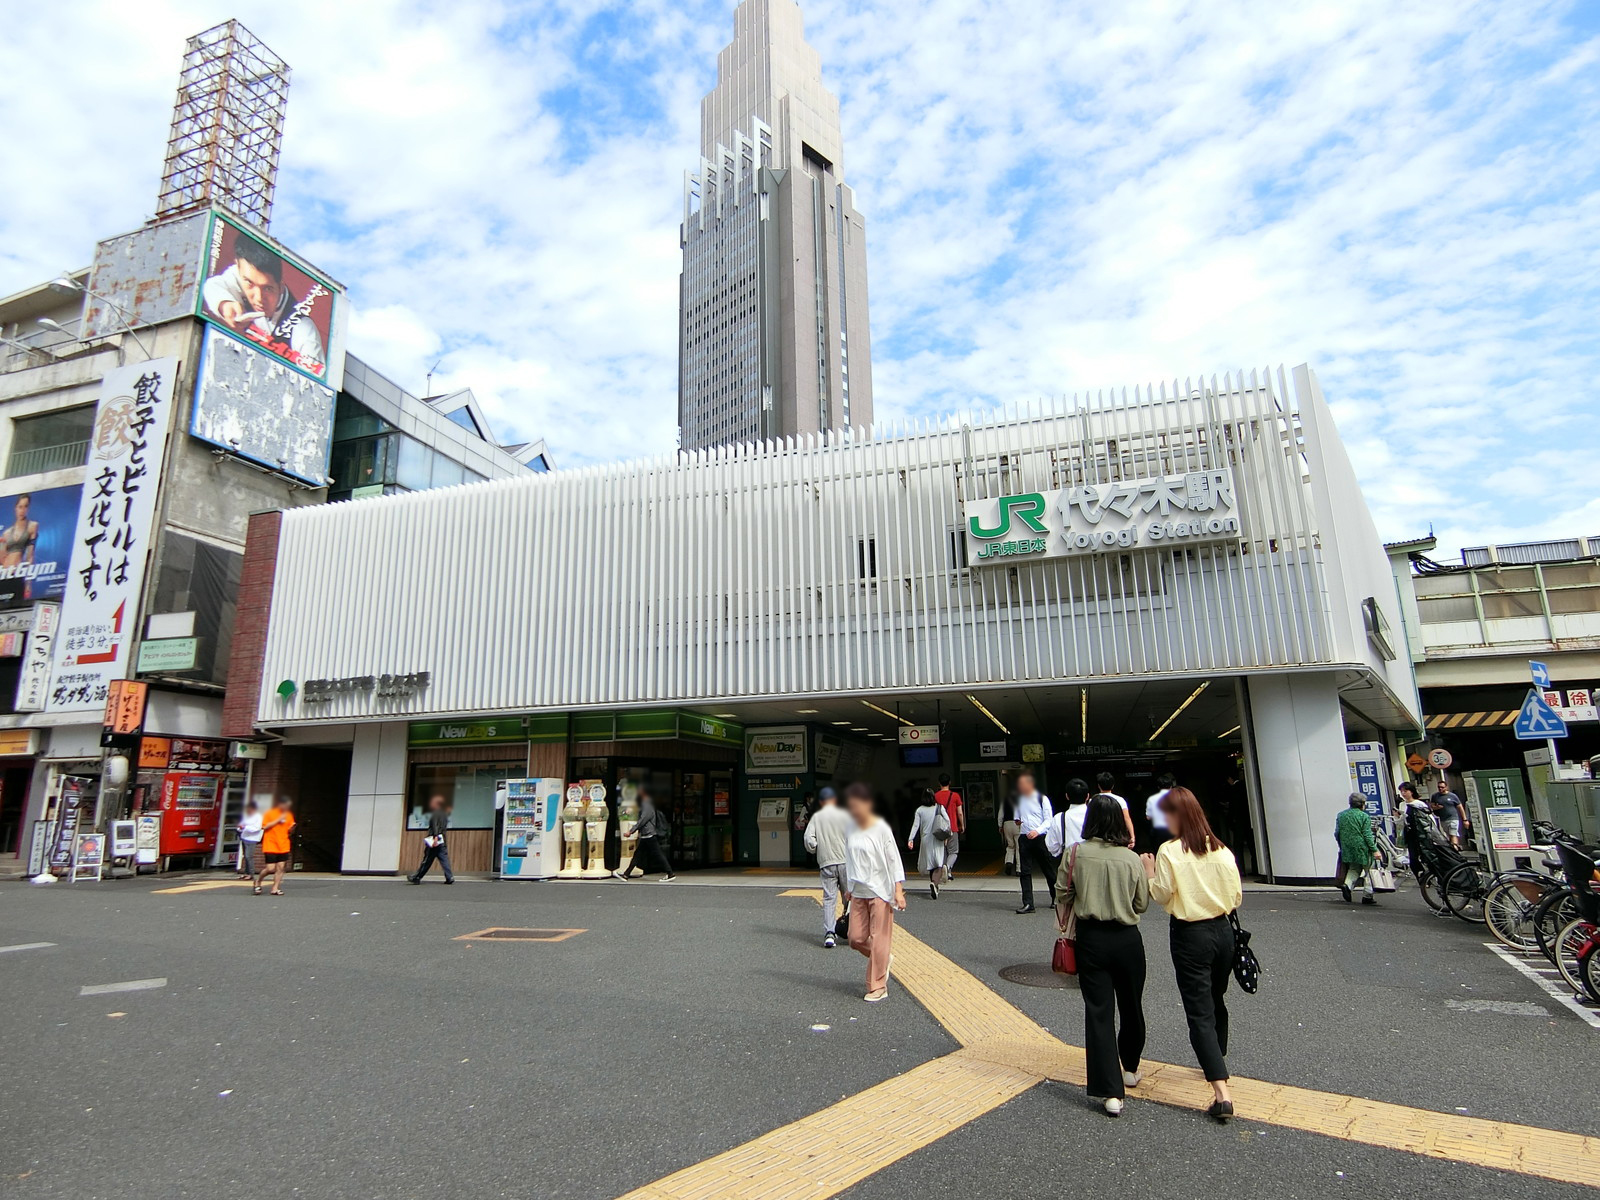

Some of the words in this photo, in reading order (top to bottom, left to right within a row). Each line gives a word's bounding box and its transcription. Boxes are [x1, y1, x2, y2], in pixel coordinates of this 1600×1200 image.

[106, 371, 162, 586] 餃子とビールは
[1057, 468, 1233, 528] 代々木駅
[969, 492, 1050, 540] JR
[1061, 524, 1138, 550] Yoyogi
[1149, 516, 1238, 541] Station
[79, 466, 118, 602] 文化です。
[977, 538, 1047, 559] JR東日本
[31, 635, 50, 673] つちや
[52, 683, 109, 705] ダンダダン酒
[439, 725, 497, 738] NewDays
[701, 720, 727, 740] NewDays
[753, 742, 802, 753] NewDays
